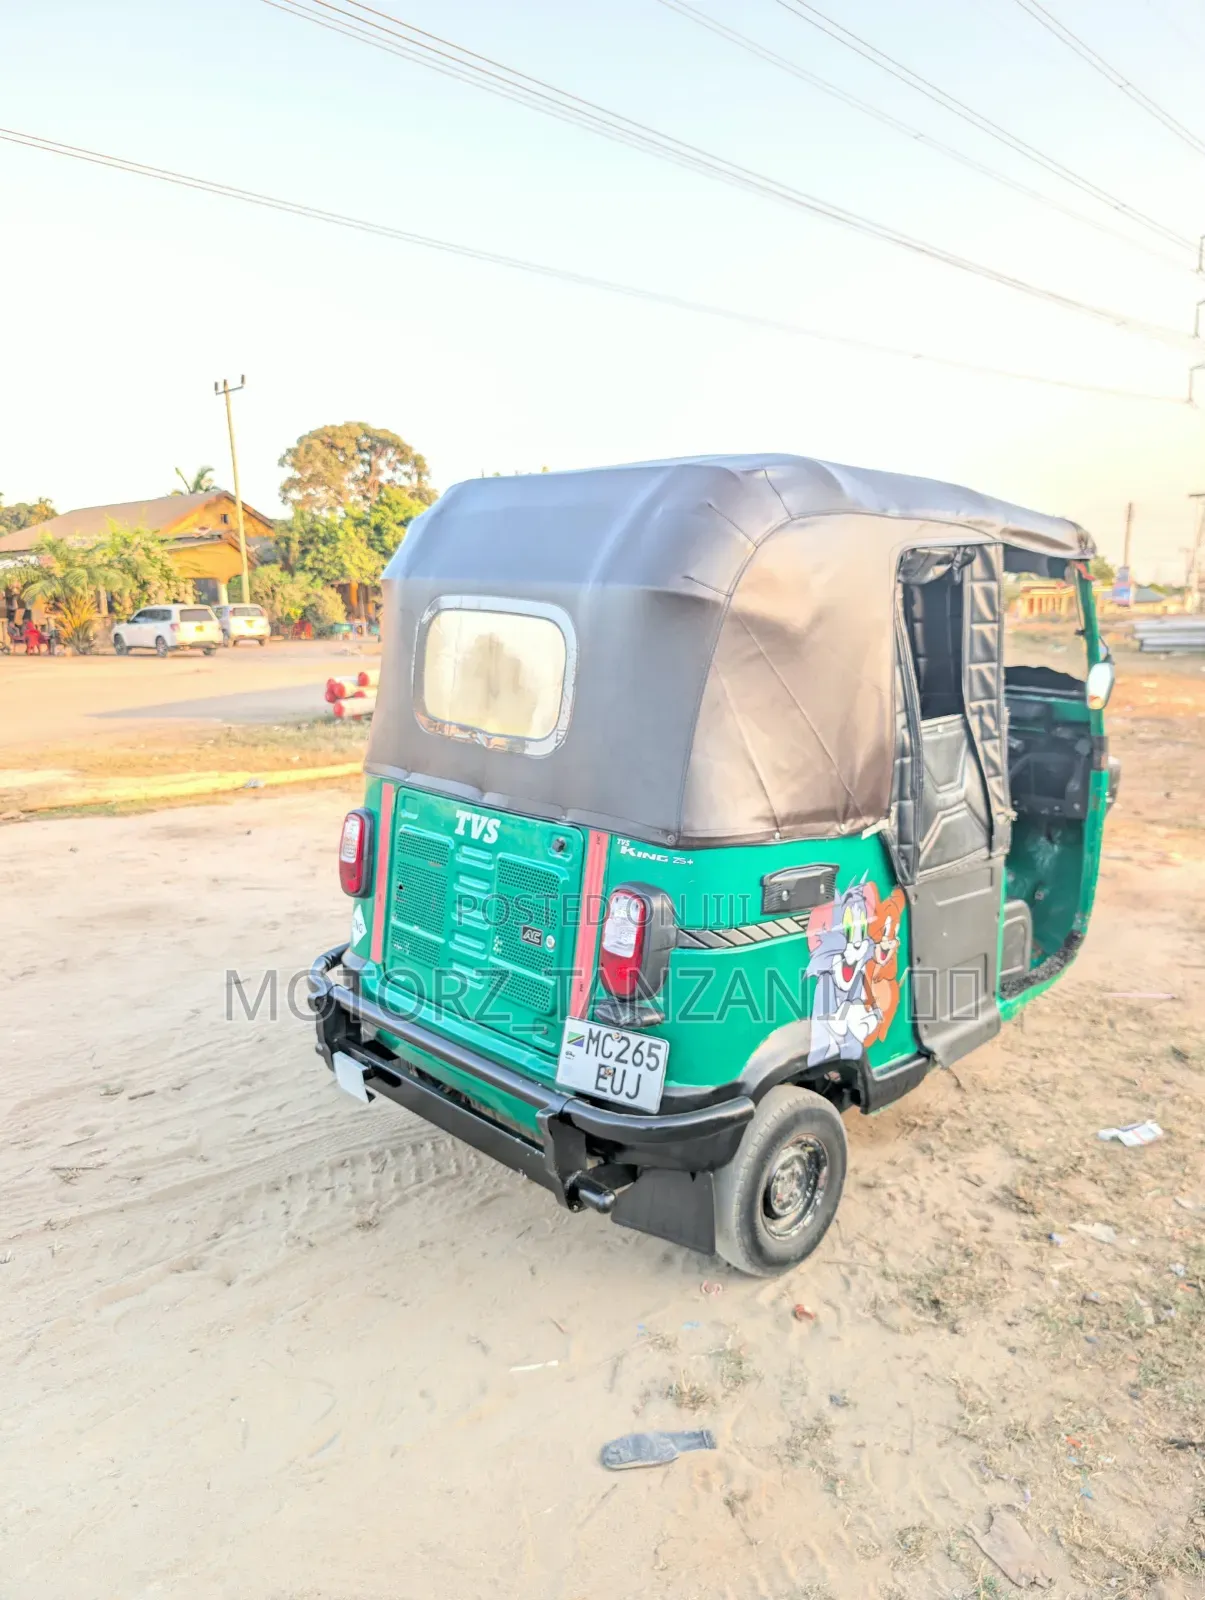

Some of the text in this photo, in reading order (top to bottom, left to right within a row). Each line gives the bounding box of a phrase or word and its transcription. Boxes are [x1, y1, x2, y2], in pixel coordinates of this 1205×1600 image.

[454, 809, 501, 844] TVS
[616, 837, 630, 847] TVS
[619, 845, 669, 863] KING
[585, 1028, 662, 1072] MC265
[595, 1063, 643, 1100] EUJ
